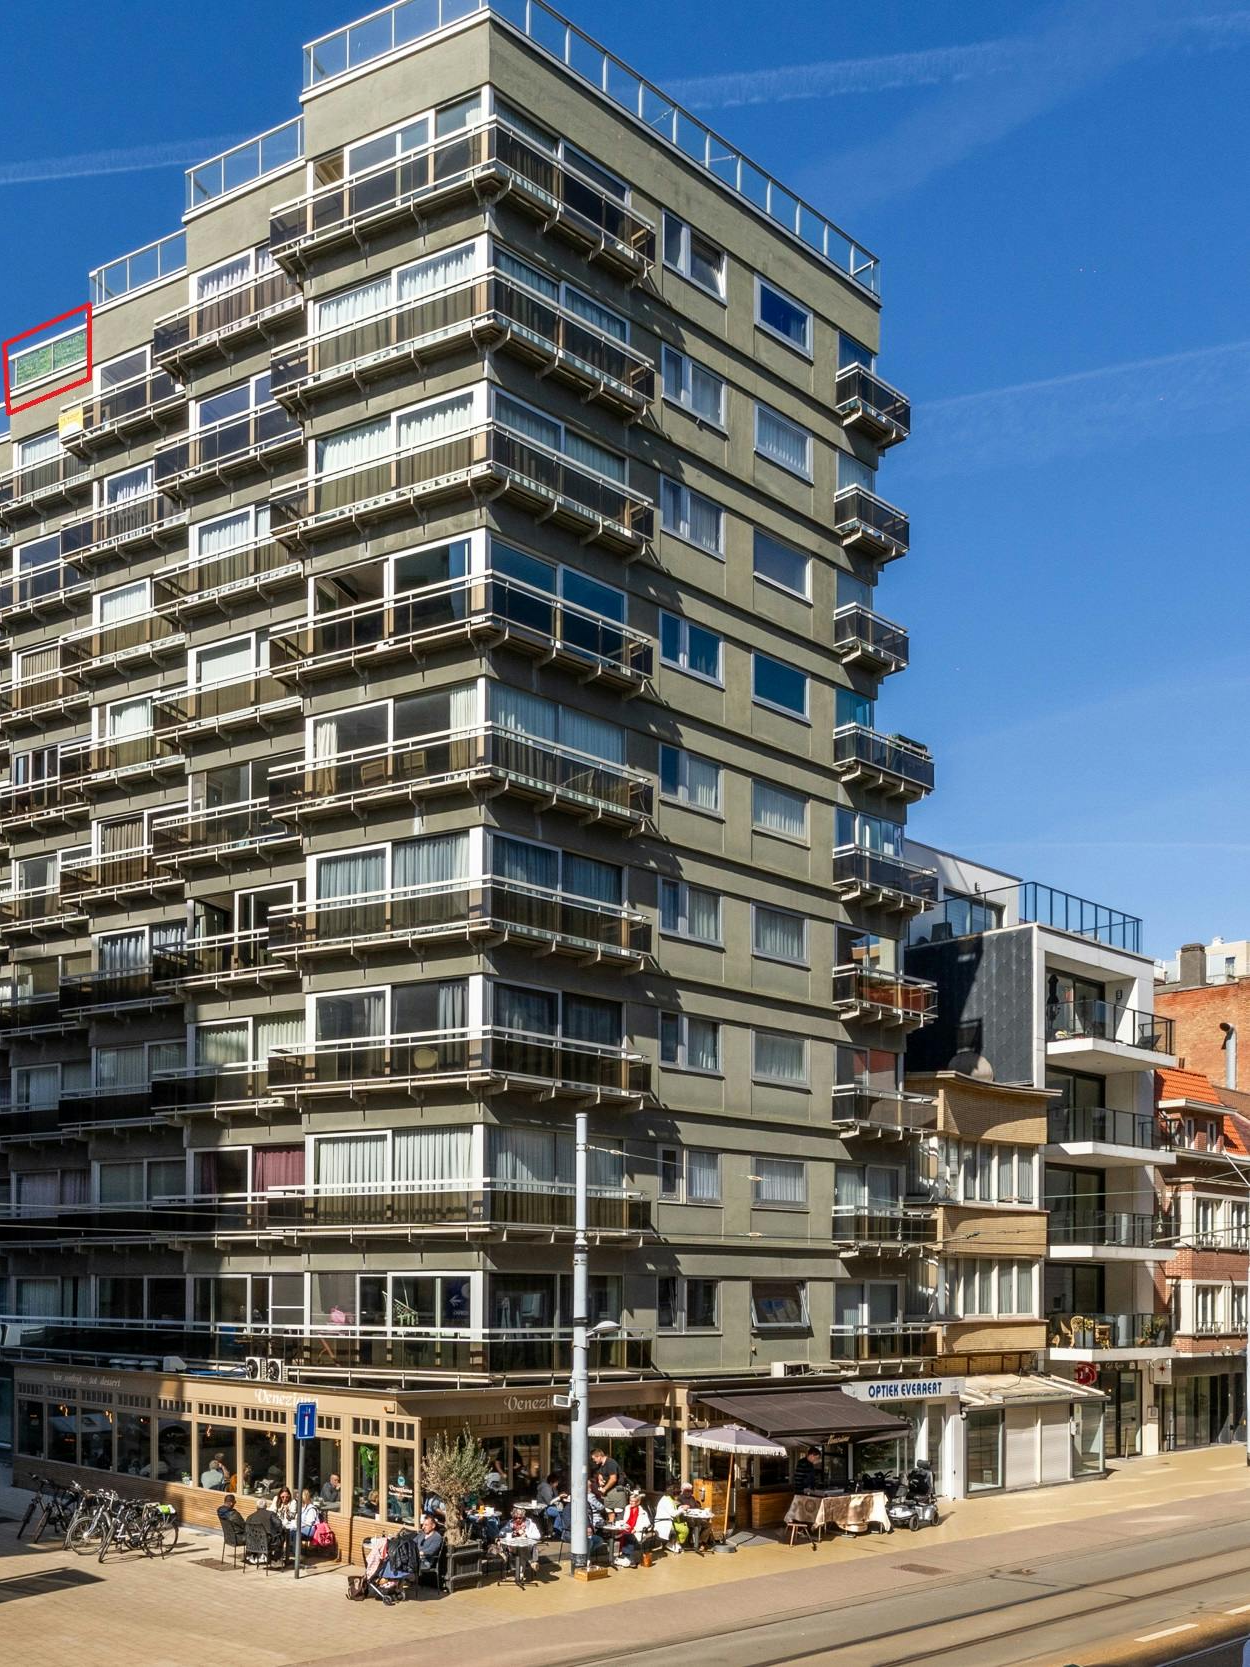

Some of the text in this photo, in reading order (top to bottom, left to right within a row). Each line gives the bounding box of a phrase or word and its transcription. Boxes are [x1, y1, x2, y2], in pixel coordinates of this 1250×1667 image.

[868, 1382, 943, 1398] OPTIEK EVERAERT
[503, 1395, 555, 1411] Venezi
